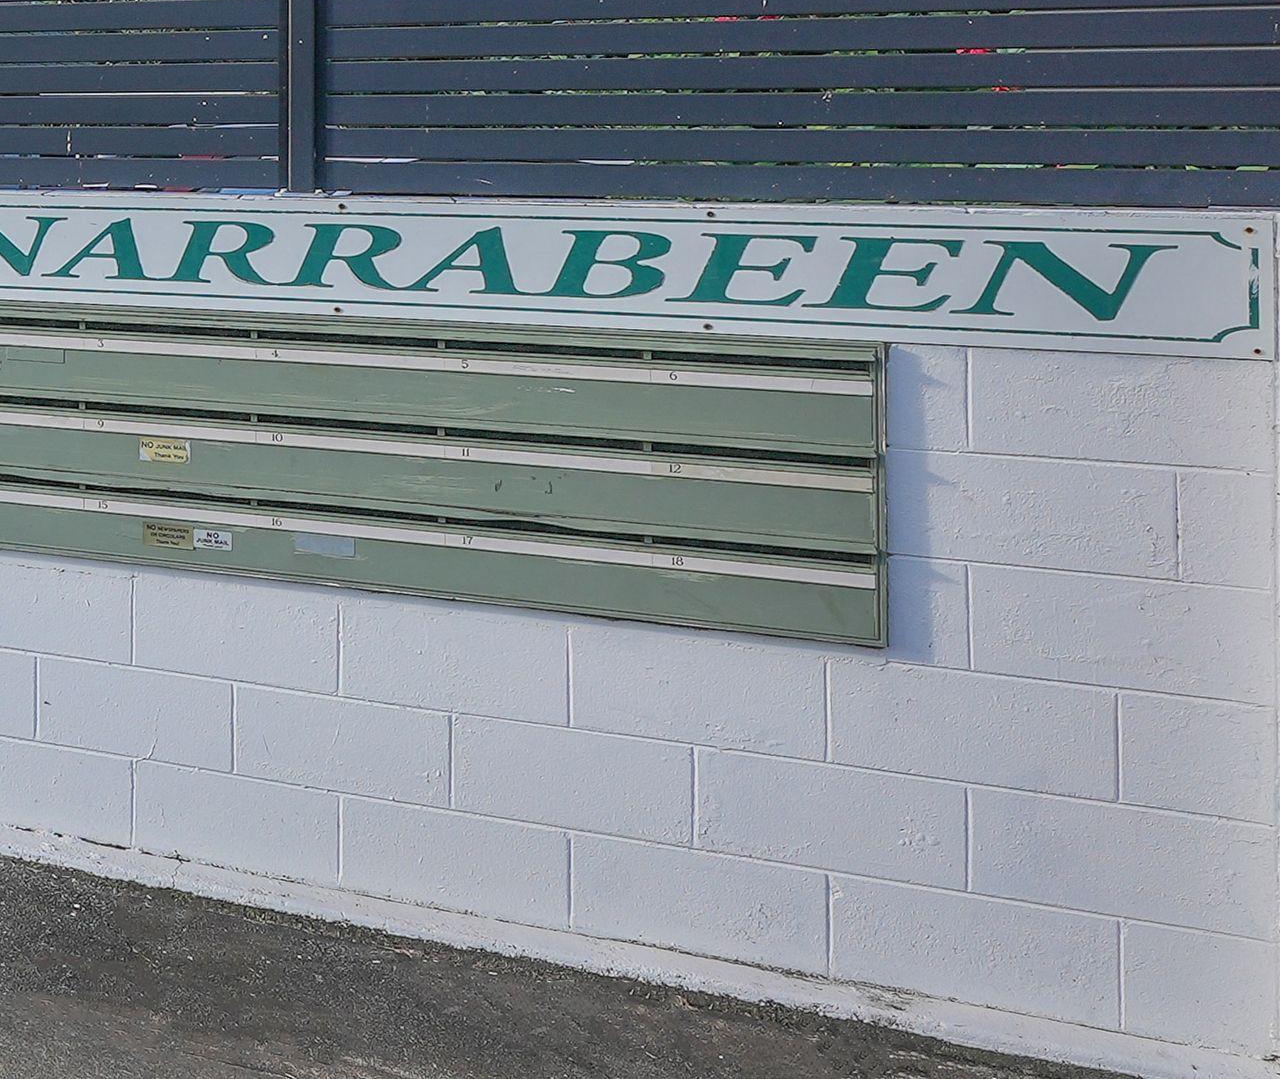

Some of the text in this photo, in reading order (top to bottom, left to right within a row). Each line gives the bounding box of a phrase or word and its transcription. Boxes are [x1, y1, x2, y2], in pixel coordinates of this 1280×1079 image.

[97, 338, 104, 348] 3
[461, 359, 469, 369] 5
[669, 371, 678, 381] 6
[97, 419, 104, 429] 9
[271, 433, 283, 442] 10
[141, 441, 154, 449] NO
[461, 448, 470, 457] 11
[668, 463, 681, 473] 12
[97, 500, 108, 509] 15
[271, 518, 282, 527] 16
[461, 536, 473, 545] 17
[671, 556, 684, 566] 18
